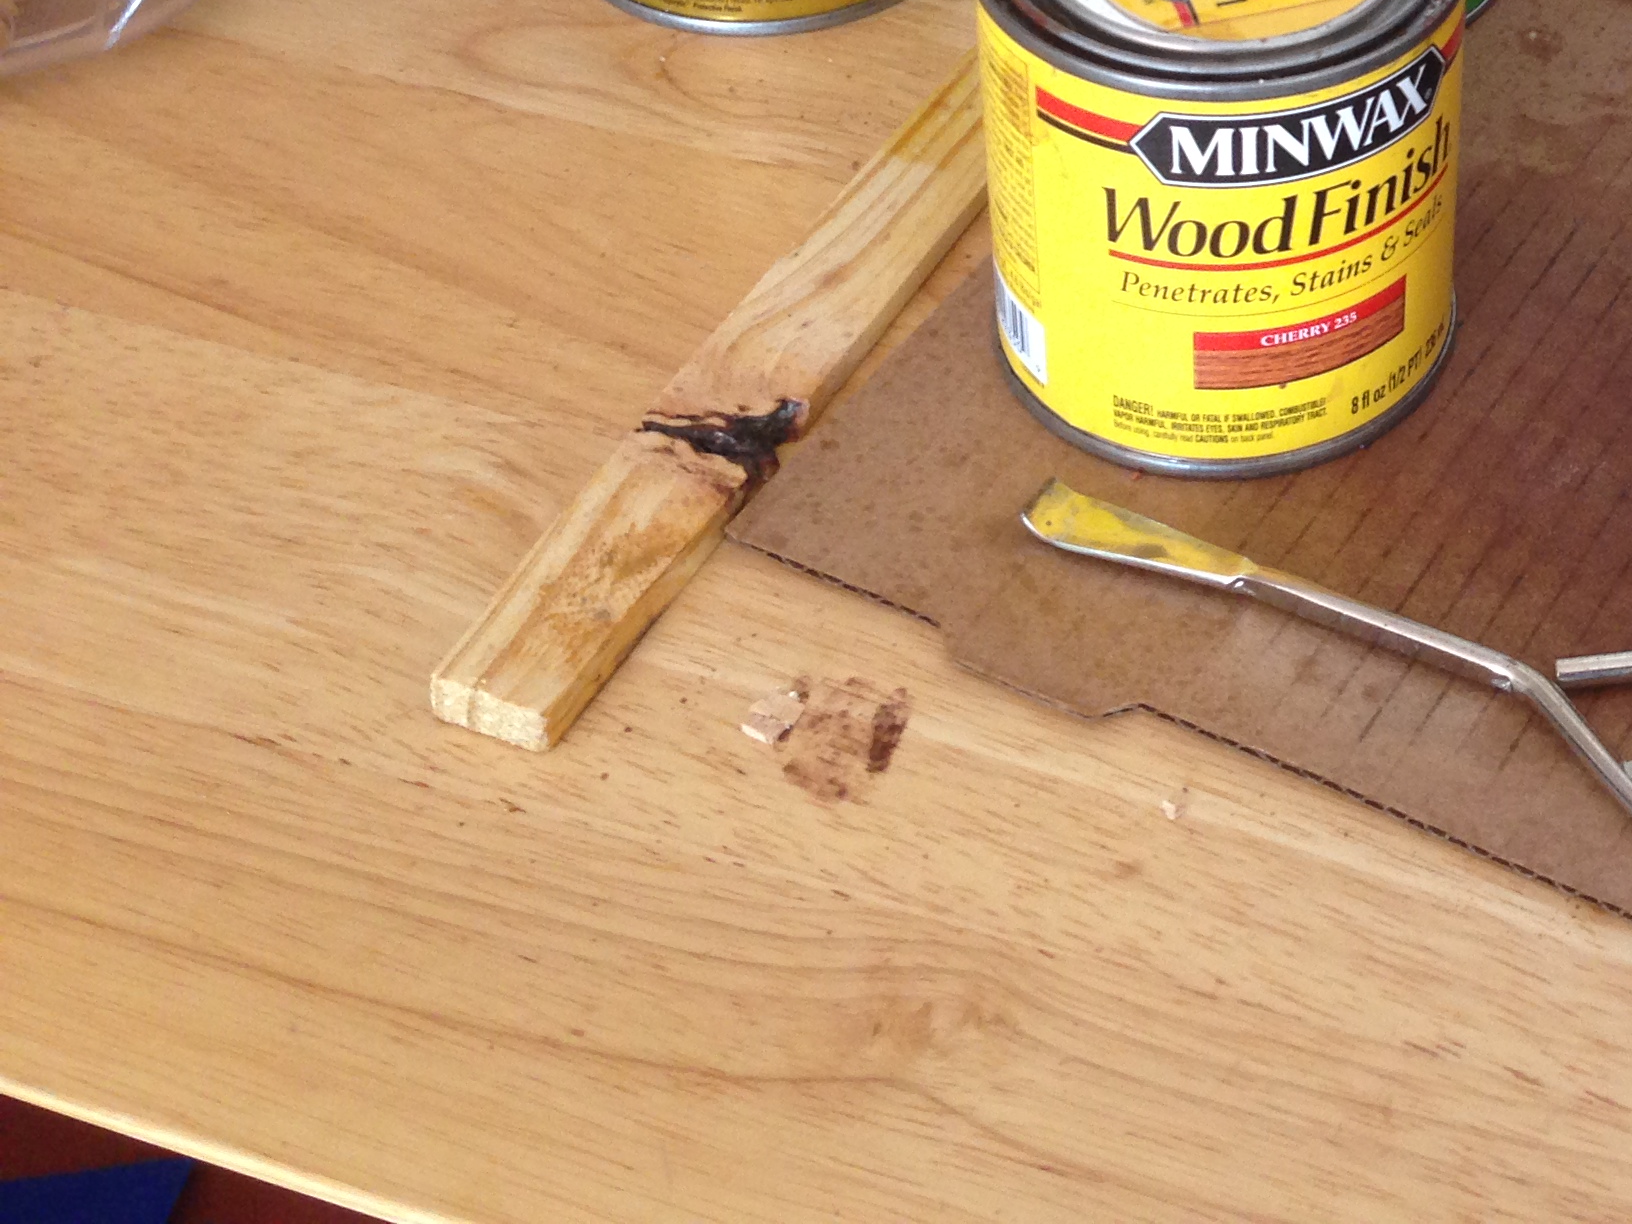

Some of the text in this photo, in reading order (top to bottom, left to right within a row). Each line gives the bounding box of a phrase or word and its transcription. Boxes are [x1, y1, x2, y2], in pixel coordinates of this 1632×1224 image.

[1168, 63, 1429, 177] MINWAX
[1101, 111, 1451, 259] Wood Finish
[1120, 193, 1444, 305] Penetrates, Stains & Seals
[1259, 311, 1358, 348] CHERRY 235
[1113, 394, 1154, 418] DANGER!
[1156, 409, 1189, 422] HARMFUL
[1190, 413, 1201, 423] OR
[1202, 413, 1222, 423] FATAL
[1223, 413, 1231, 423] IF
[1350, 395, 1360, 415] 8
[1361, 389, 1371, 410] fl
[1373, 383, 1387, 403] oz
[1113, 408, 1134, 422] VAPOR
[1170, 421, 1204, 433] IRRITATES
[1226, 422, 1243, 433] SKIN
[1244, 421, 1259, 432] AND
[1260, 413, 1305, 430] RESPIRATORY
[1194, 432, 1229, 444] CAUTIONS
